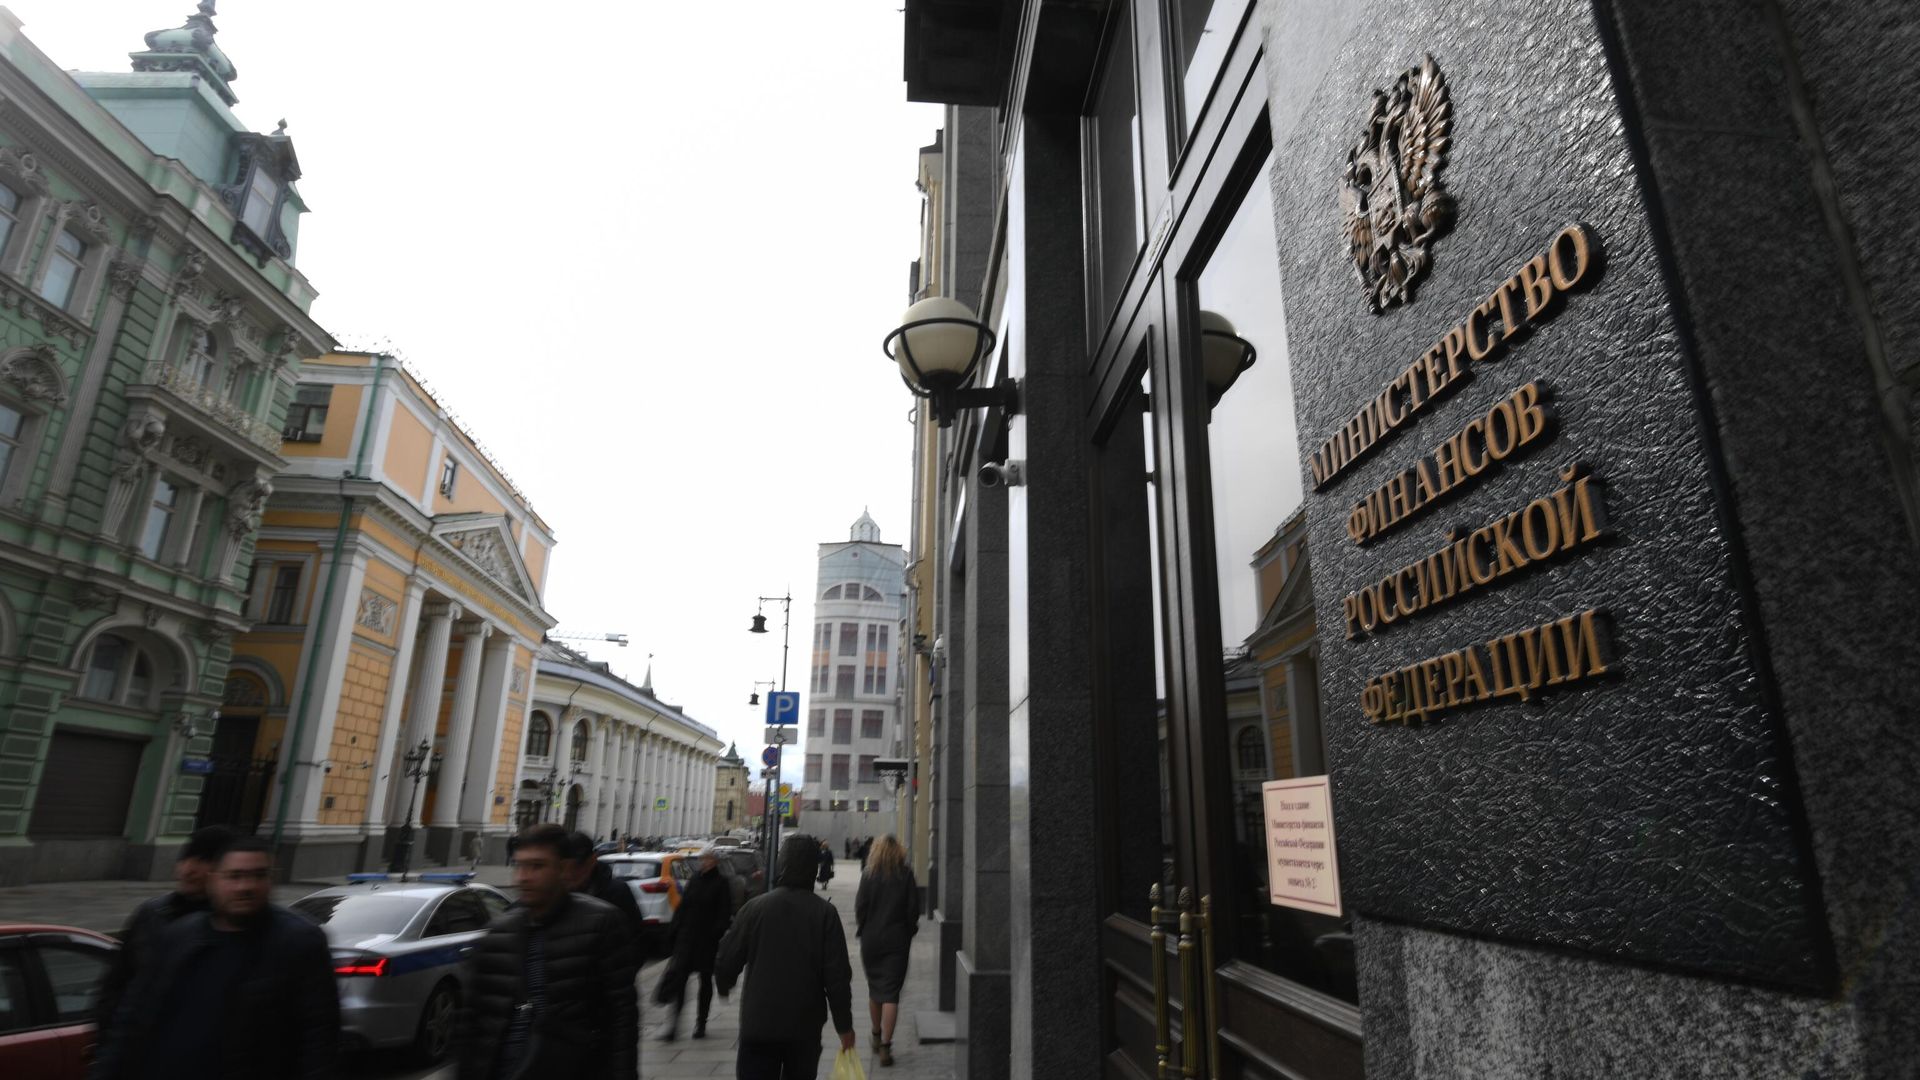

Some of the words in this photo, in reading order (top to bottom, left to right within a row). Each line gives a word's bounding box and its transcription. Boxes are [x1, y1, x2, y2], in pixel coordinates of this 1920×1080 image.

[1310, 222, 1596, 492] МИНИСТЕРСТВО
[1347, 379, 1550, 545] ФИНАНСОВ
[1343, 464, 1605, 639] РОССИЙСКОЙ
[774, 695, 794, 721] P
[1359, 610, 1608, 725] ФЕДЕРАЦИИ
